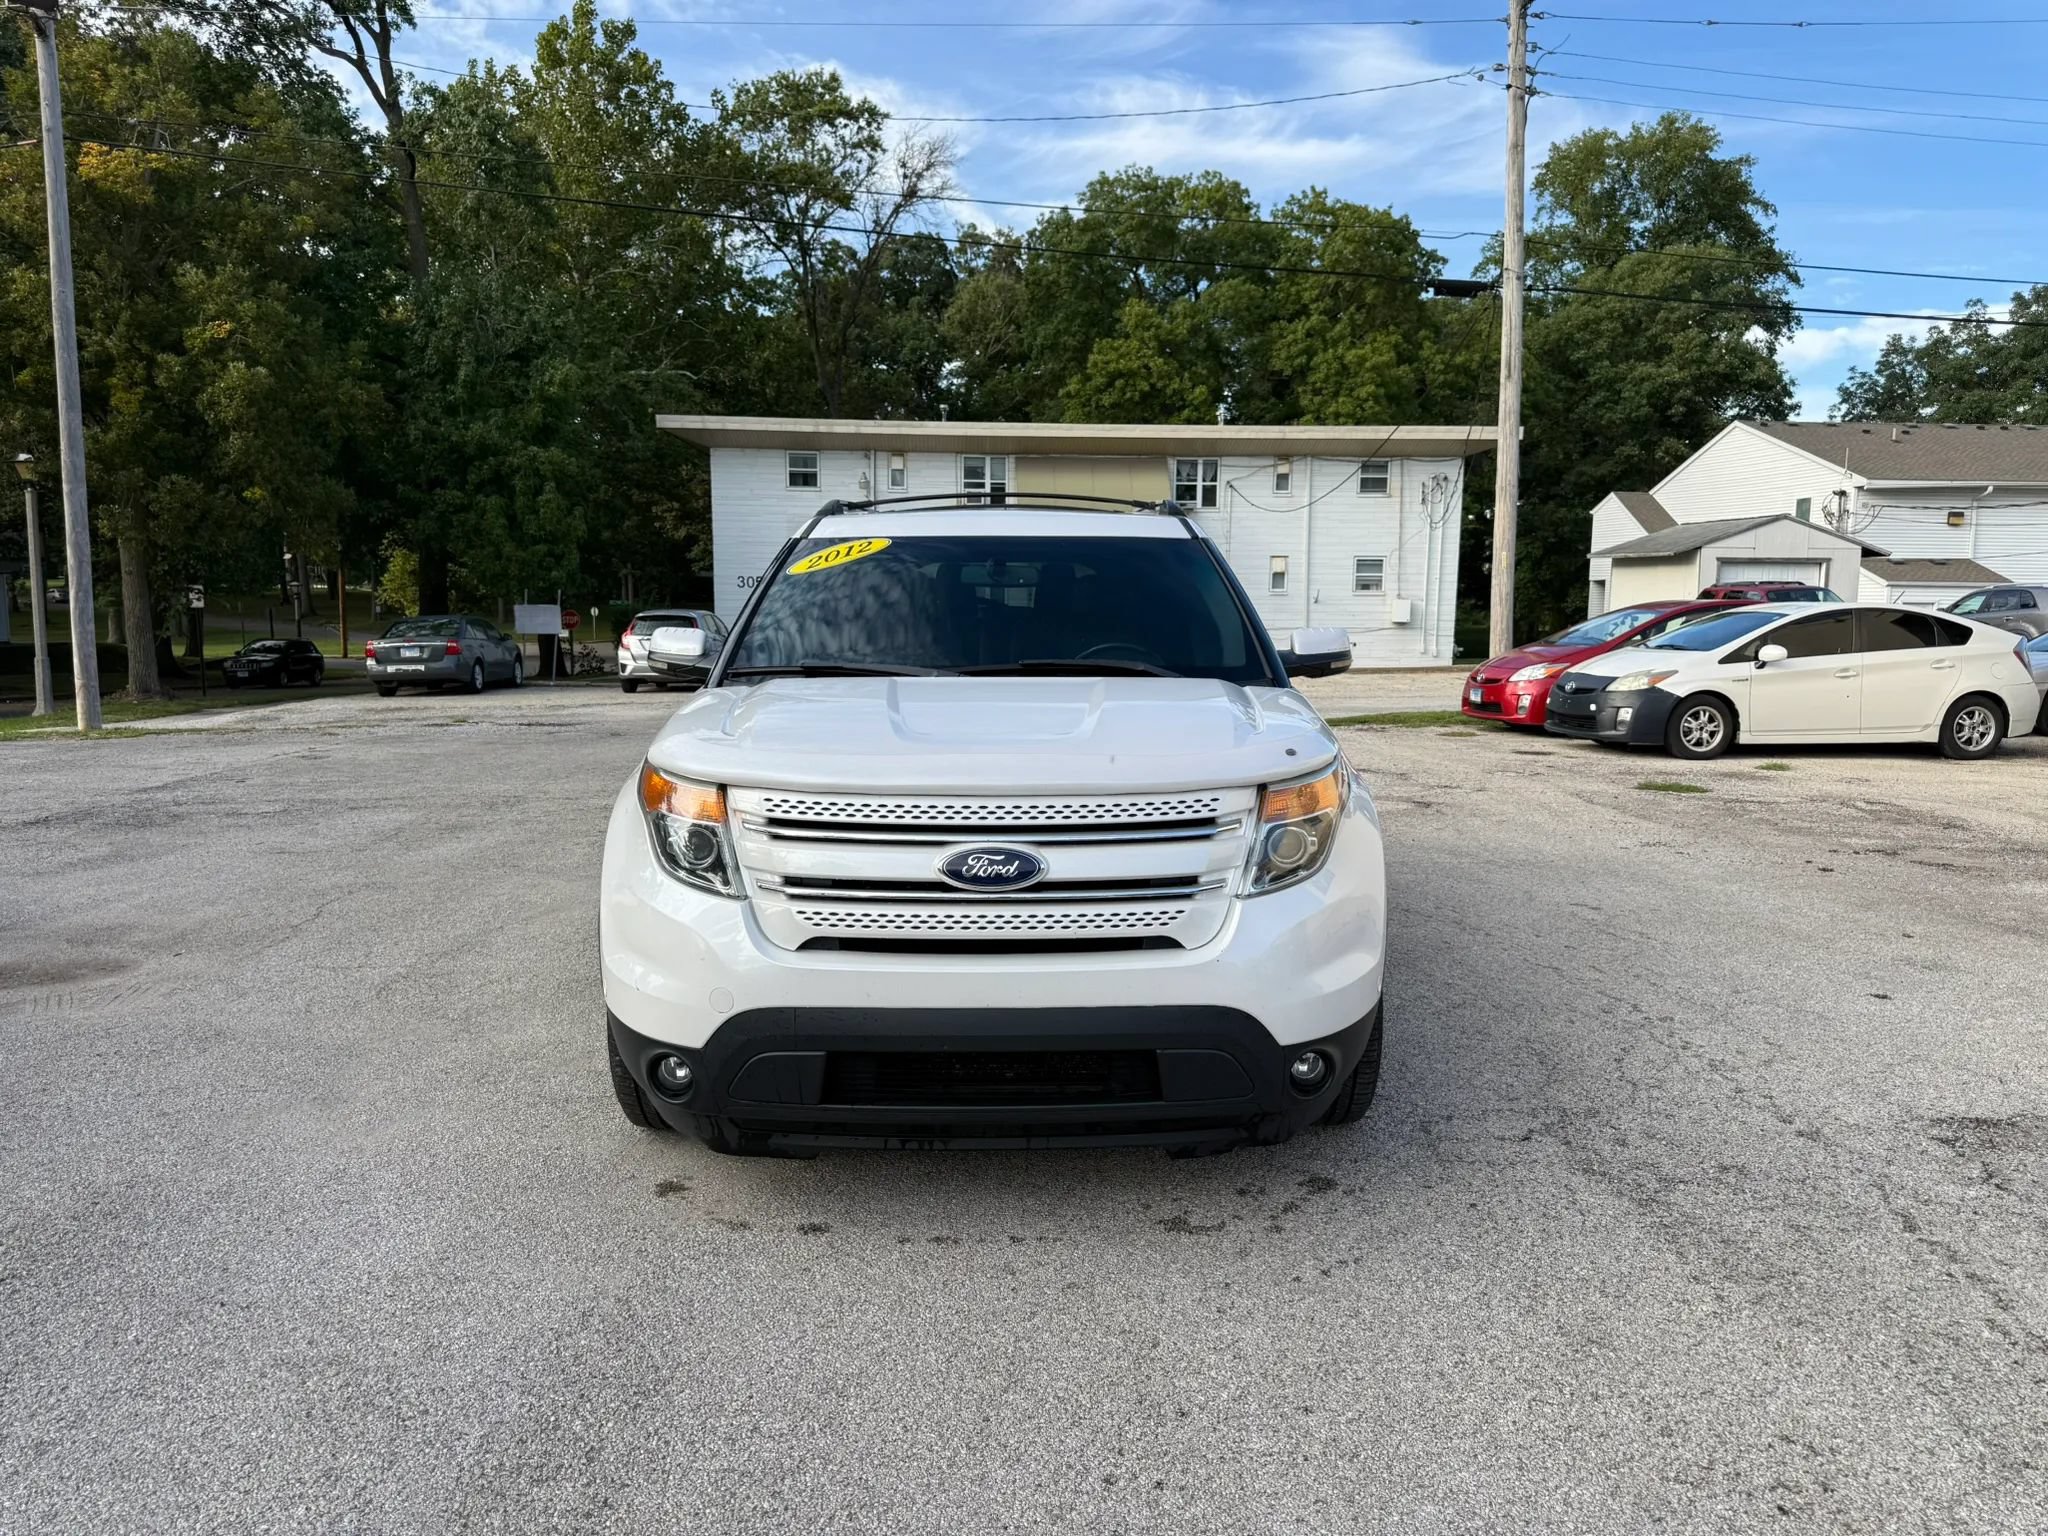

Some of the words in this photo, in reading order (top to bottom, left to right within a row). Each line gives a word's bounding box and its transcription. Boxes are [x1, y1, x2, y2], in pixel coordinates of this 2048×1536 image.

[806, 541, 873, 569] 2012
[562, 615, 579, 624] STOP
[962, 854, 1019, 877] Ford
